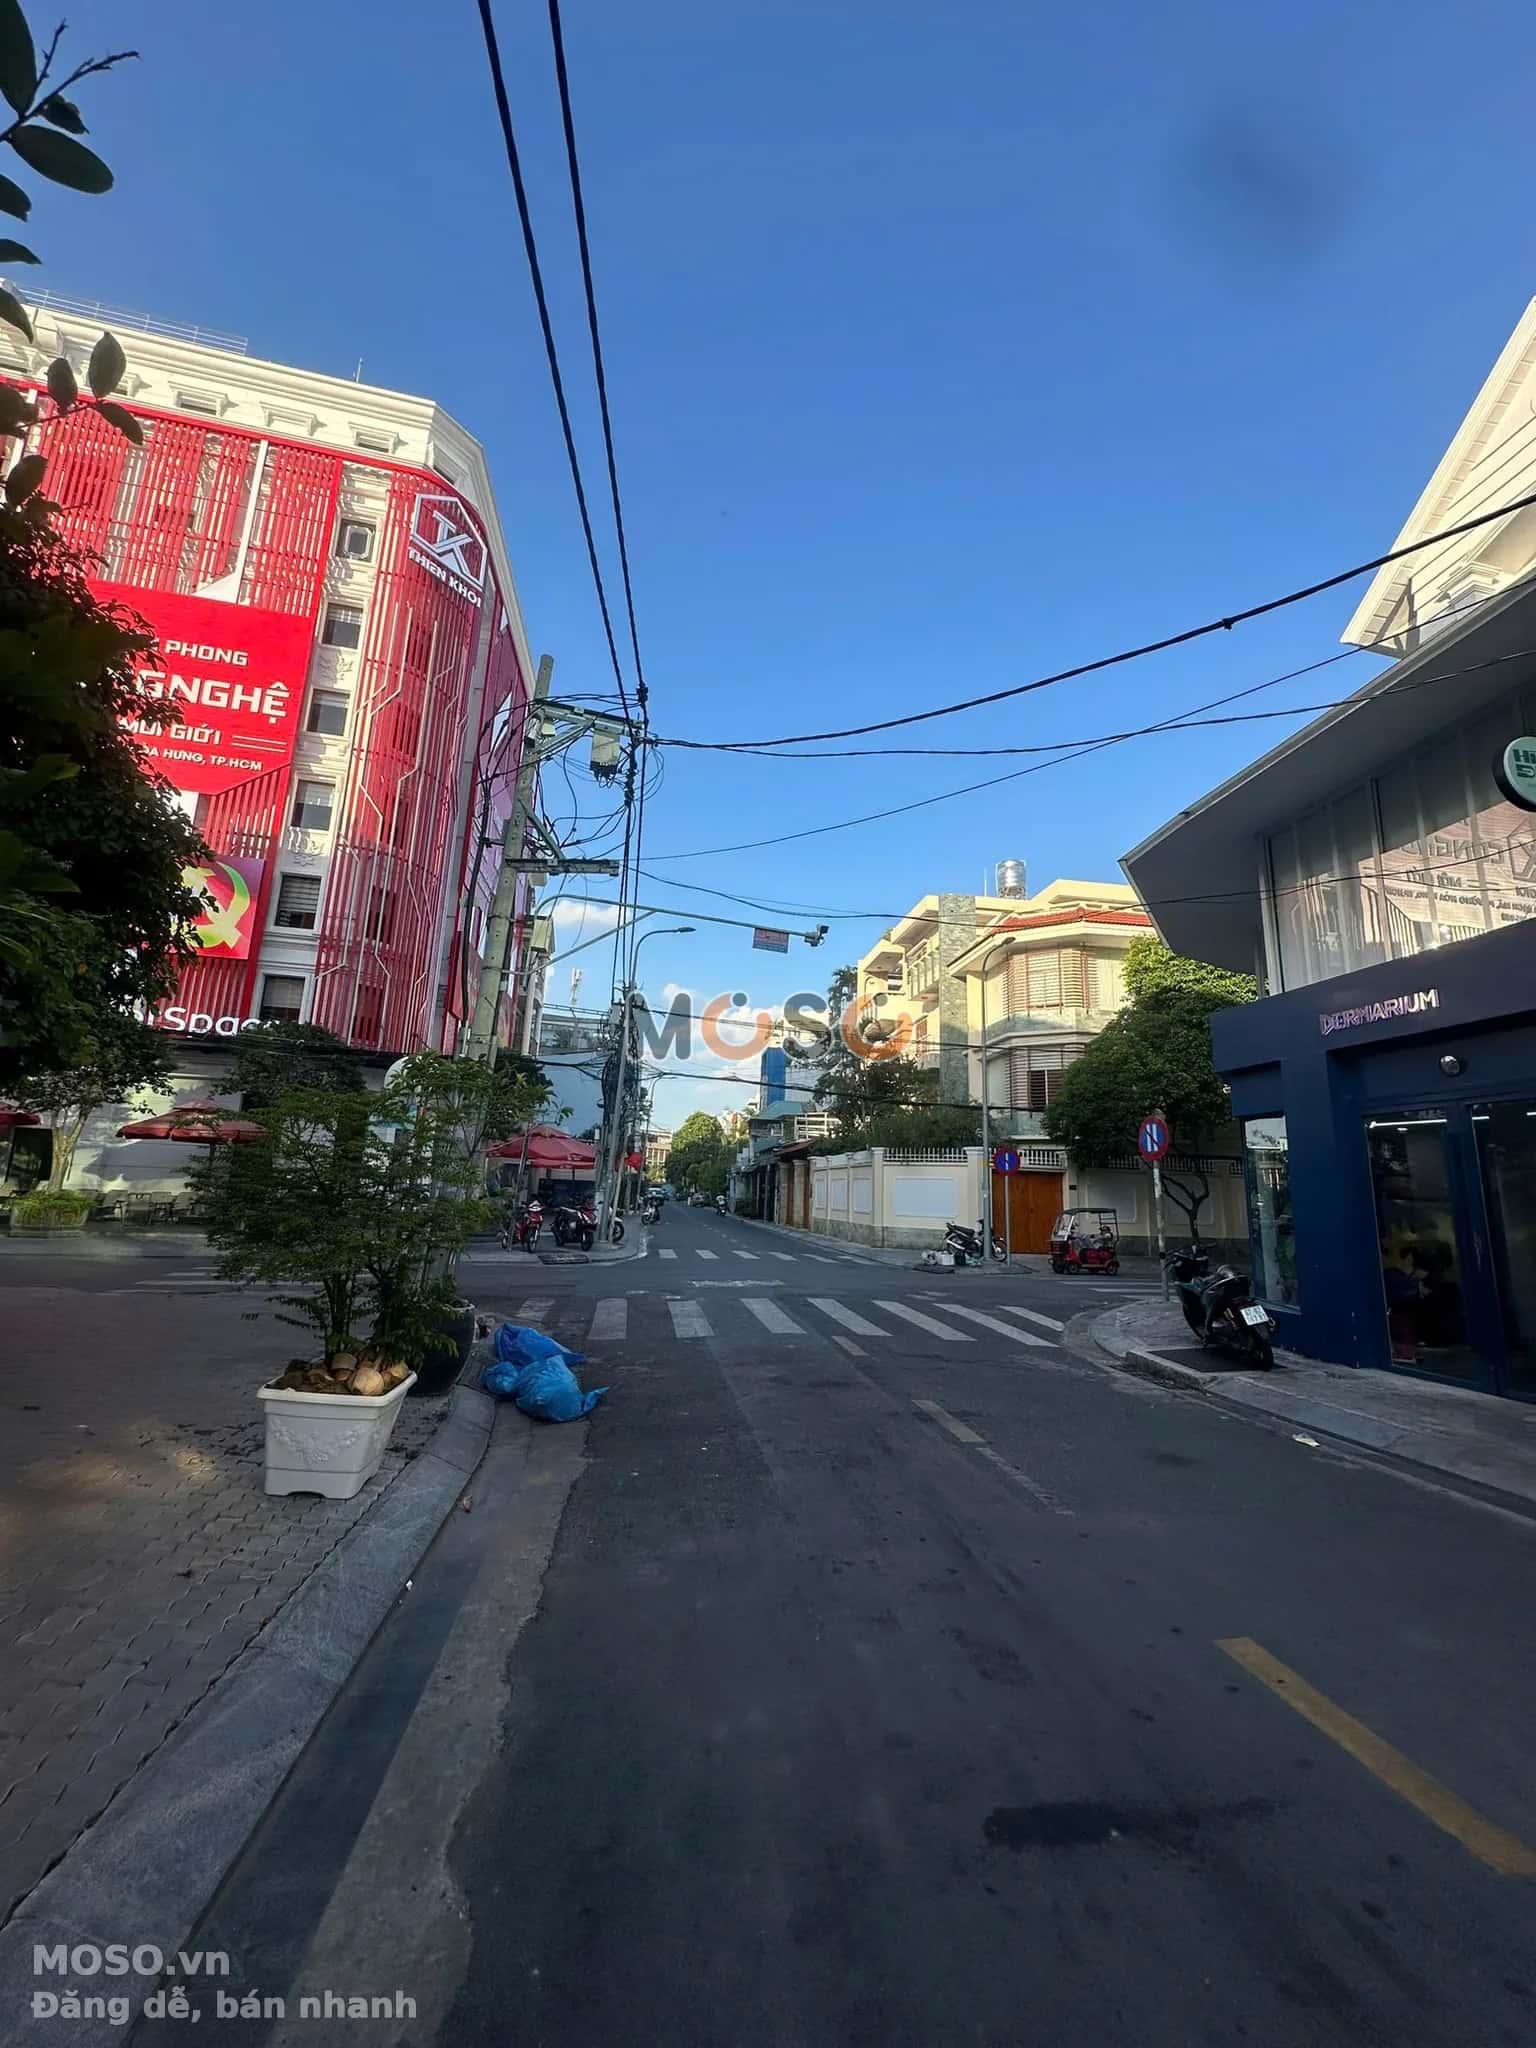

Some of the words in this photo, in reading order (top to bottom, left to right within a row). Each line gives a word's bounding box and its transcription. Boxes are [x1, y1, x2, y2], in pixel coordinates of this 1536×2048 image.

[165, 639, 249, 667] PHONG
[135, 669, 290, 724] GNGHỆ
[170, 721, 222, 745] GIỚI
[210, 755, 263, 771] TP.HCM
[1319, 989, 1440, 1035] DERMARIUM
